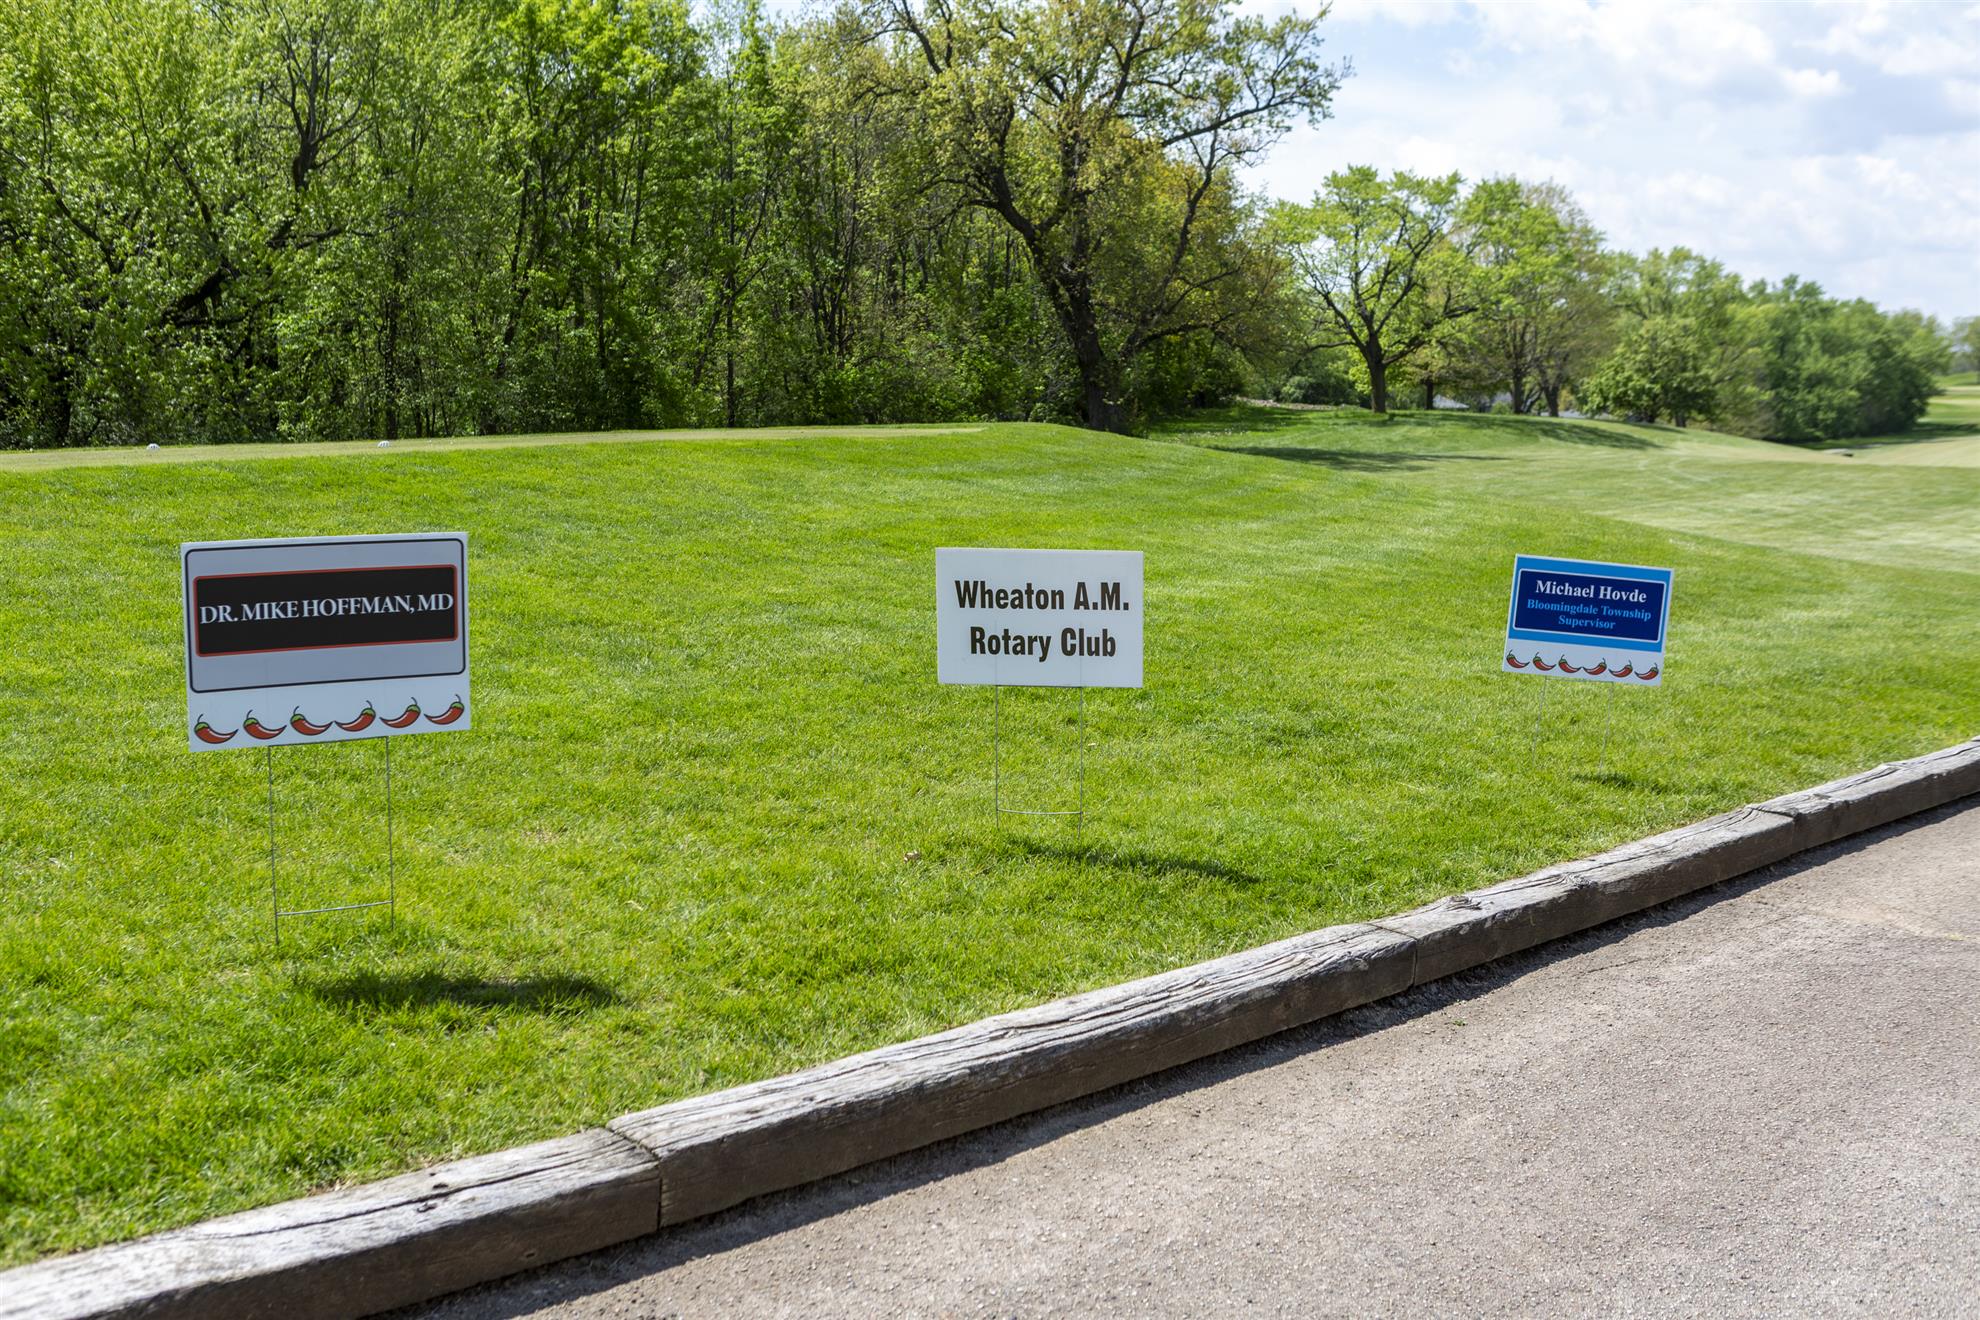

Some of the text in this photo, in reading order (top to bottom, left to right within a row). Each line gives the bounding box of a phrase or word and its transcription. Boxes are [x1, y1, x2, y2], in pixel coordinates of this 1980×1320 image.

[955, 580, 1130, 611] Wheaton A.M.
[1535, 579, 1648, 603] Michael Hovde
[199, 593, 454, 624] DR. MIKE HOFFMAN, MD
[1527, 598, 1652, 622] Bloomingdale Township
[1558, 615, 1616, 630] Supervisor
[970, 626, 1116, 663] Rotary Club
